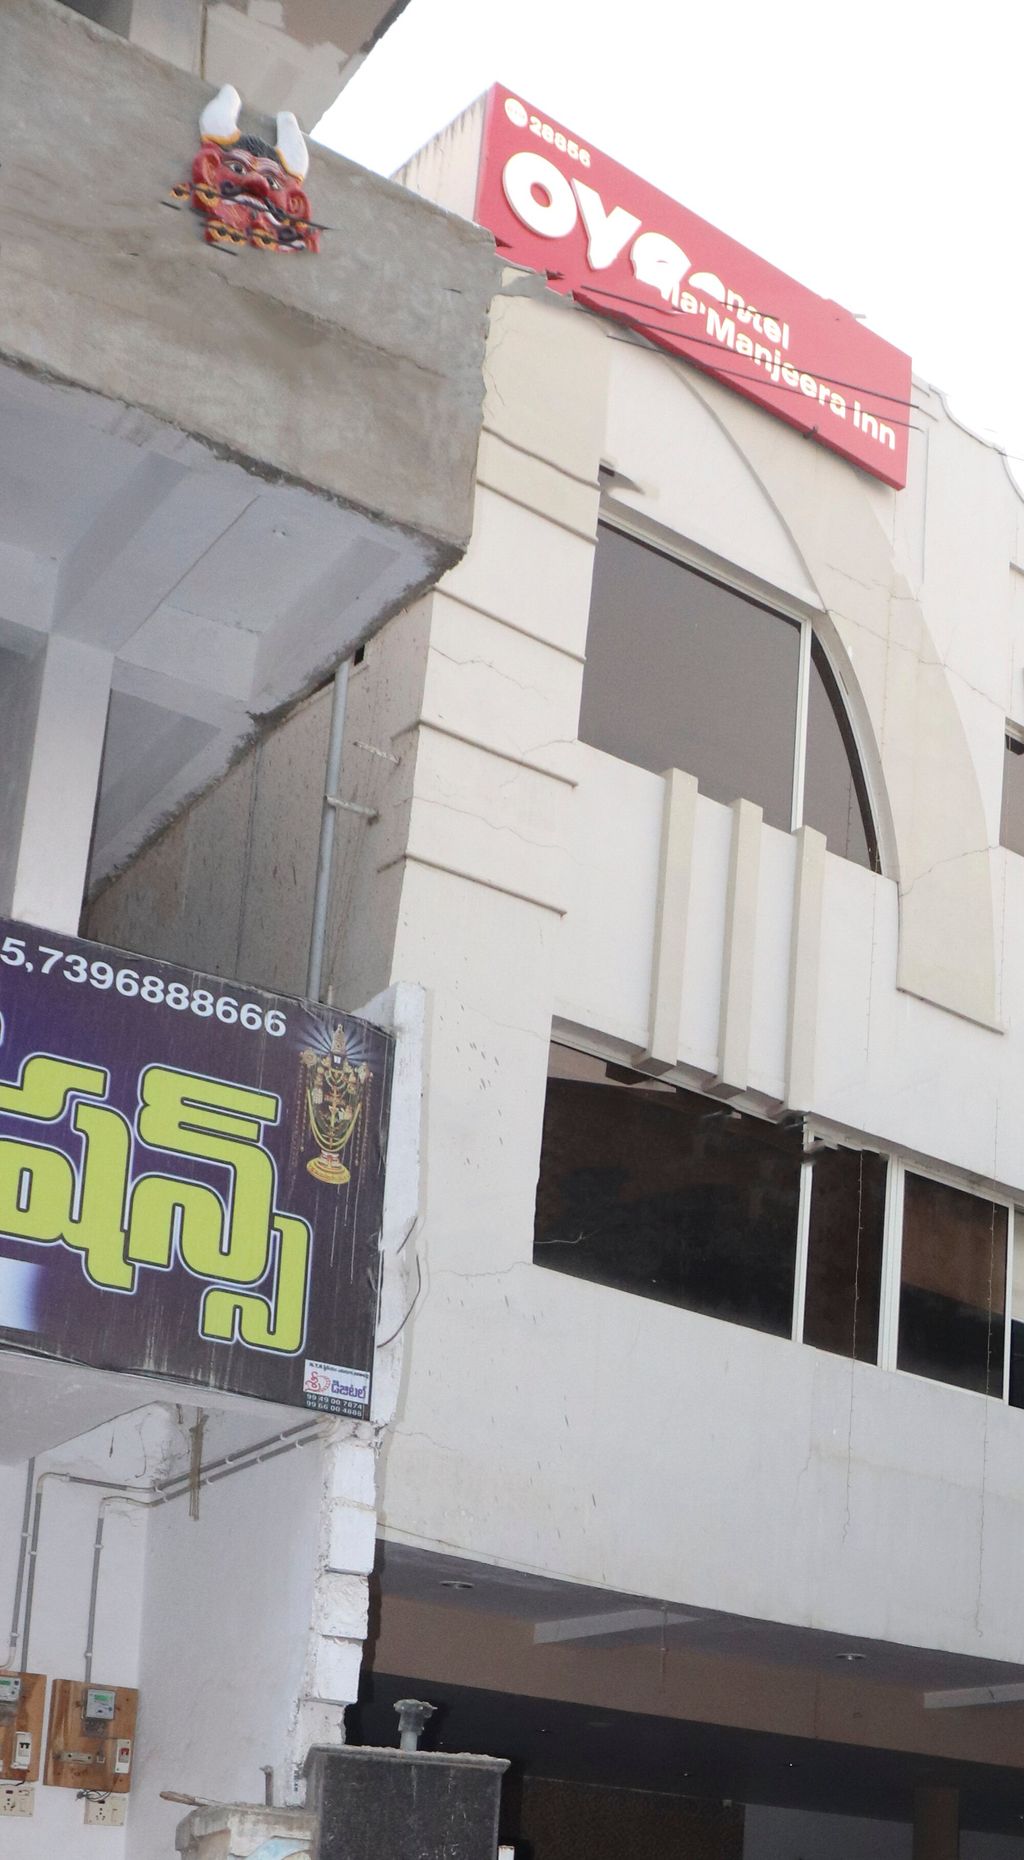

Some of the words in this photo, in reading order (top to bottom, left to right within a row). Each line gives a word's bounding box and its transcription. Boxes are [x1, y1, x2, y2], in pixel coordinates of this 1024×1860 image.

[706, 306, 846, 420] Manjeera
[853, 400, 896, 450] Inn
[0, 937, 287, 1037] 5,7396888666
